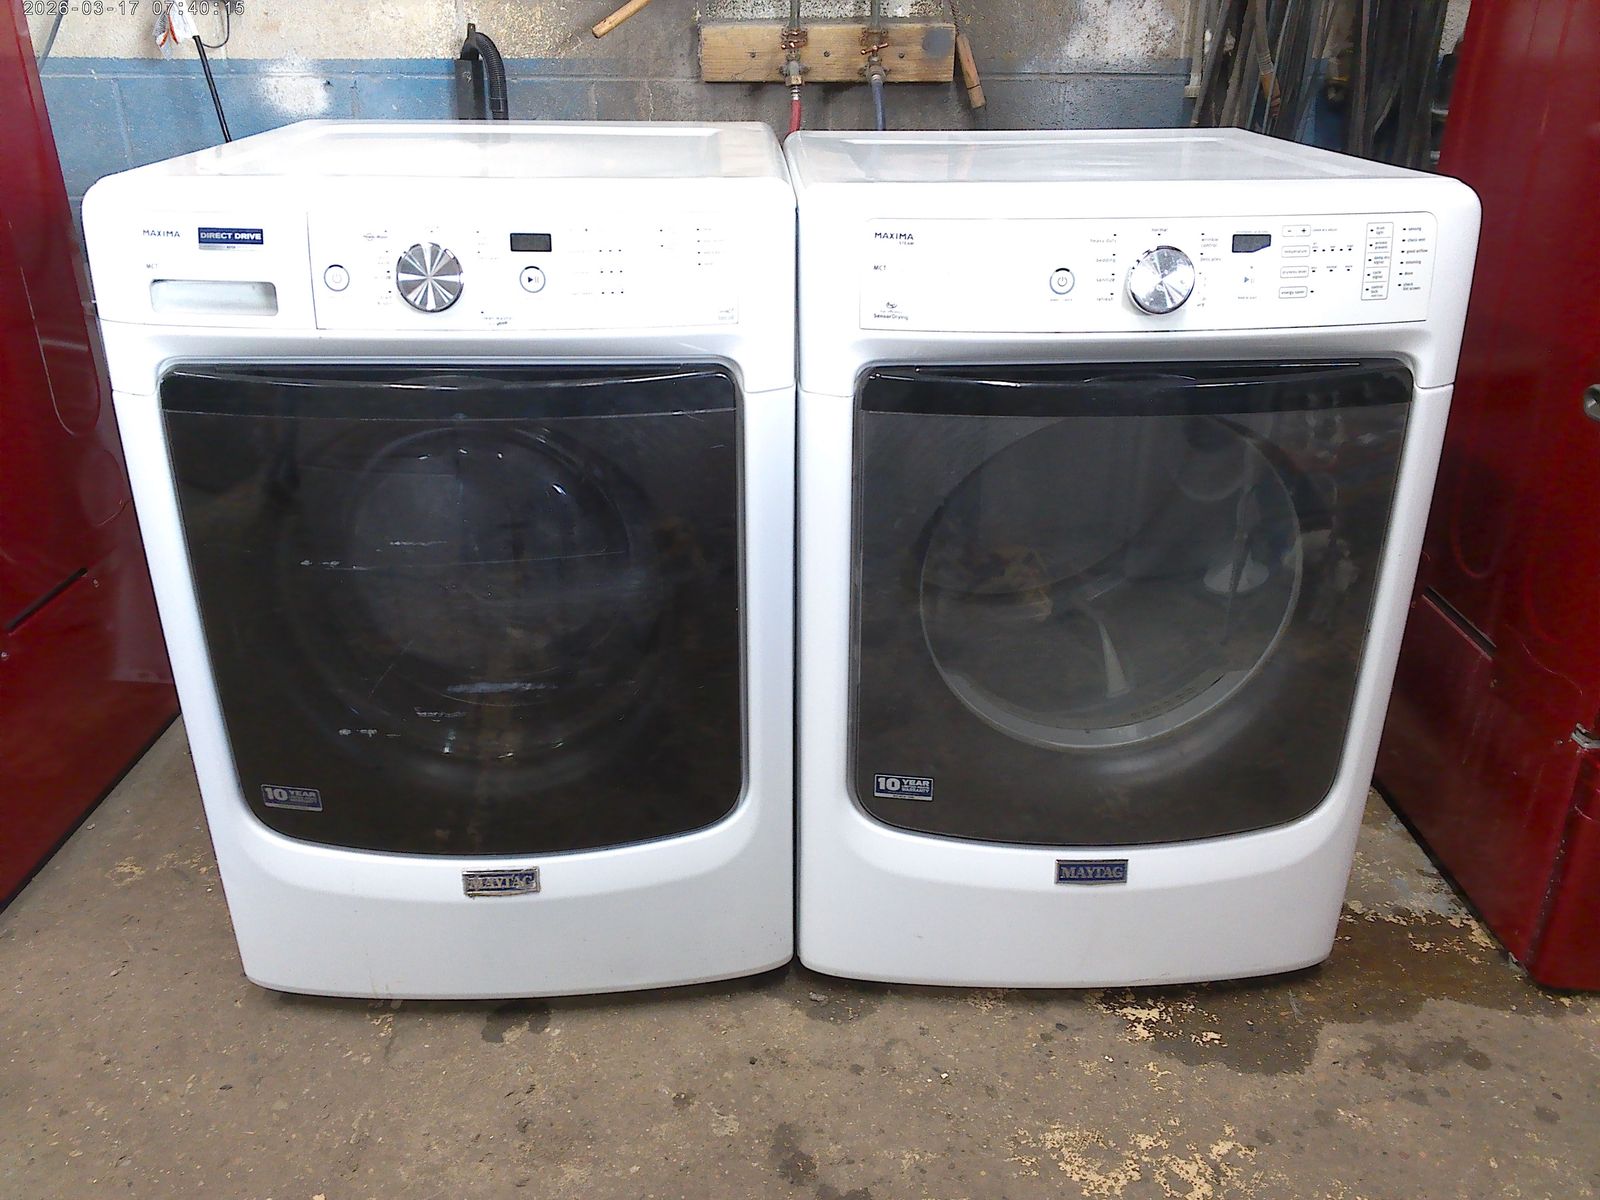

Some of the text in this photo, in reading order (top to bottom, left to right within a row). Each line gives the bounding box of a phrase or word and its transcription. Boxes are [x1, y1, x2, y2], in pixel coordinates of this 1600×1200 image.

[143, 229, 181, 238] MAXIMA
[200, 231, 262, 241] DIRECT DRIVE
[874, 231, 914, 240] MAXIMA
[878, 777, 930, 791] 10 YEAR
[265, 787, 289, 801] 10
[288, 789, 316, 797] YEAR
[1060, 866, 1124, 879] MAYTAG
